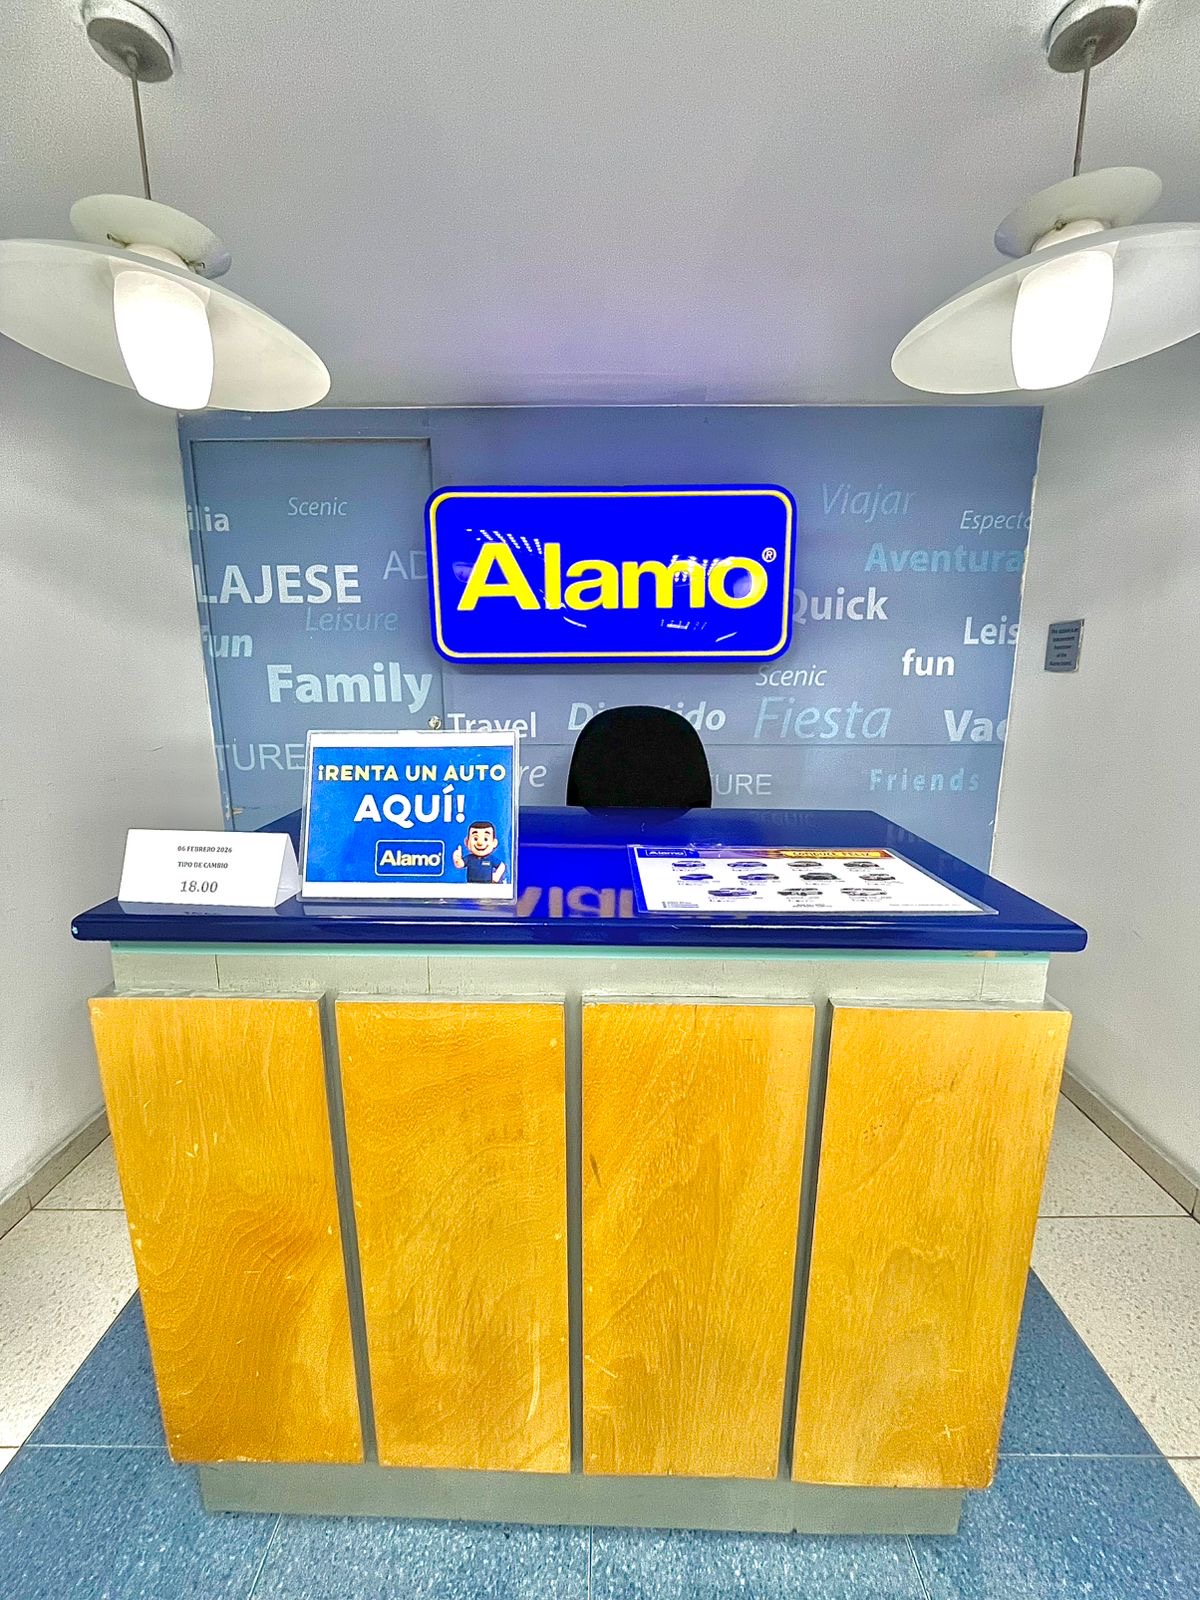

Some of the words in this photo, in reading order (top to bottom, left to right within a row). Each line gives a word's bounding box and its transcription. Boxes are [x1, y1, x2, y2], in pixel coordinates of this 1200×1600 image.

[288, 498, 348, 517] Scenic
[821, 483, 917, 523] Viajar
[864, 543, 1025, 573] Aventura
[792, 587, 889, 625] Quick
[306, 607, 397, 632] Leisure
[901, 648, 955, 677] fun
[266, 663, 433, 713] Family
[755, 664, 828, 688] Scenic
[447, 711, 536, 738] Travel
[753, 695, 893, 740] Fiesta
[405, 764, 437, 782] UN
[443, 764, 506, 782] AUTO
[710, 774, 773, 795] URE
[869, 768, 980, 792] Friends
[354, 783, 466, 829] AQUÍ!
[186, 845, 216, 853] FEBRERO
[203, 861, 228, 869] CAMBIO
[180, 880, 218, 893] 18.00
